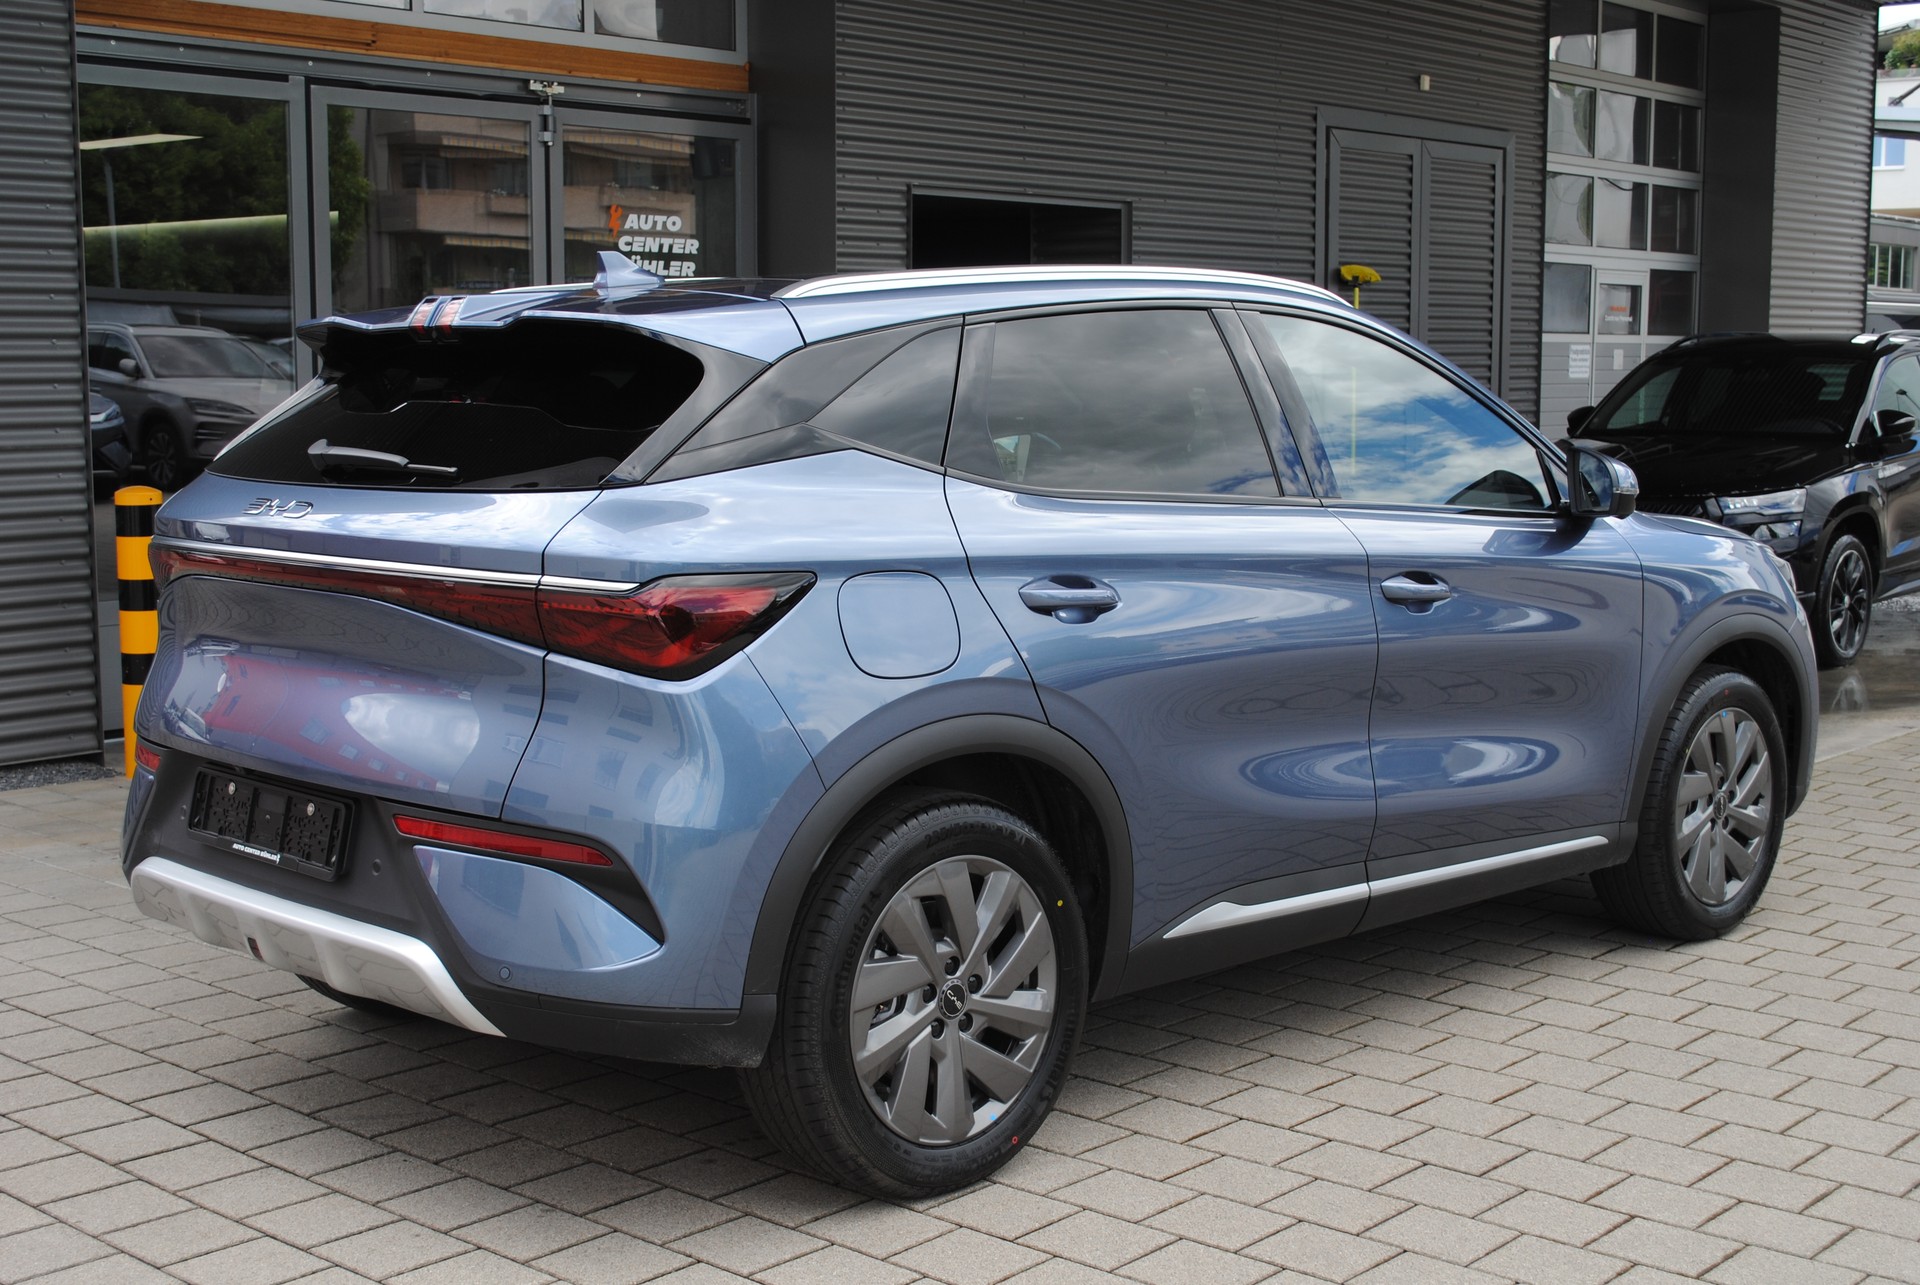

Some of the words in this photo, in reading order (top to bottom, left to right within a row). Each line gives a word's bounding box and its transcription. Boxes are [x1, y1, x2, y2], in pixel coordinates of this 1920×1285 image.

[624, 214, 682, 231] AUTO
[618, 236, 699, 254] CENTER
[631, 255, 696, 277] ÜHLER
[242, 497, 313, 518] BYD
[233, 843, 245, 851] AUTO
